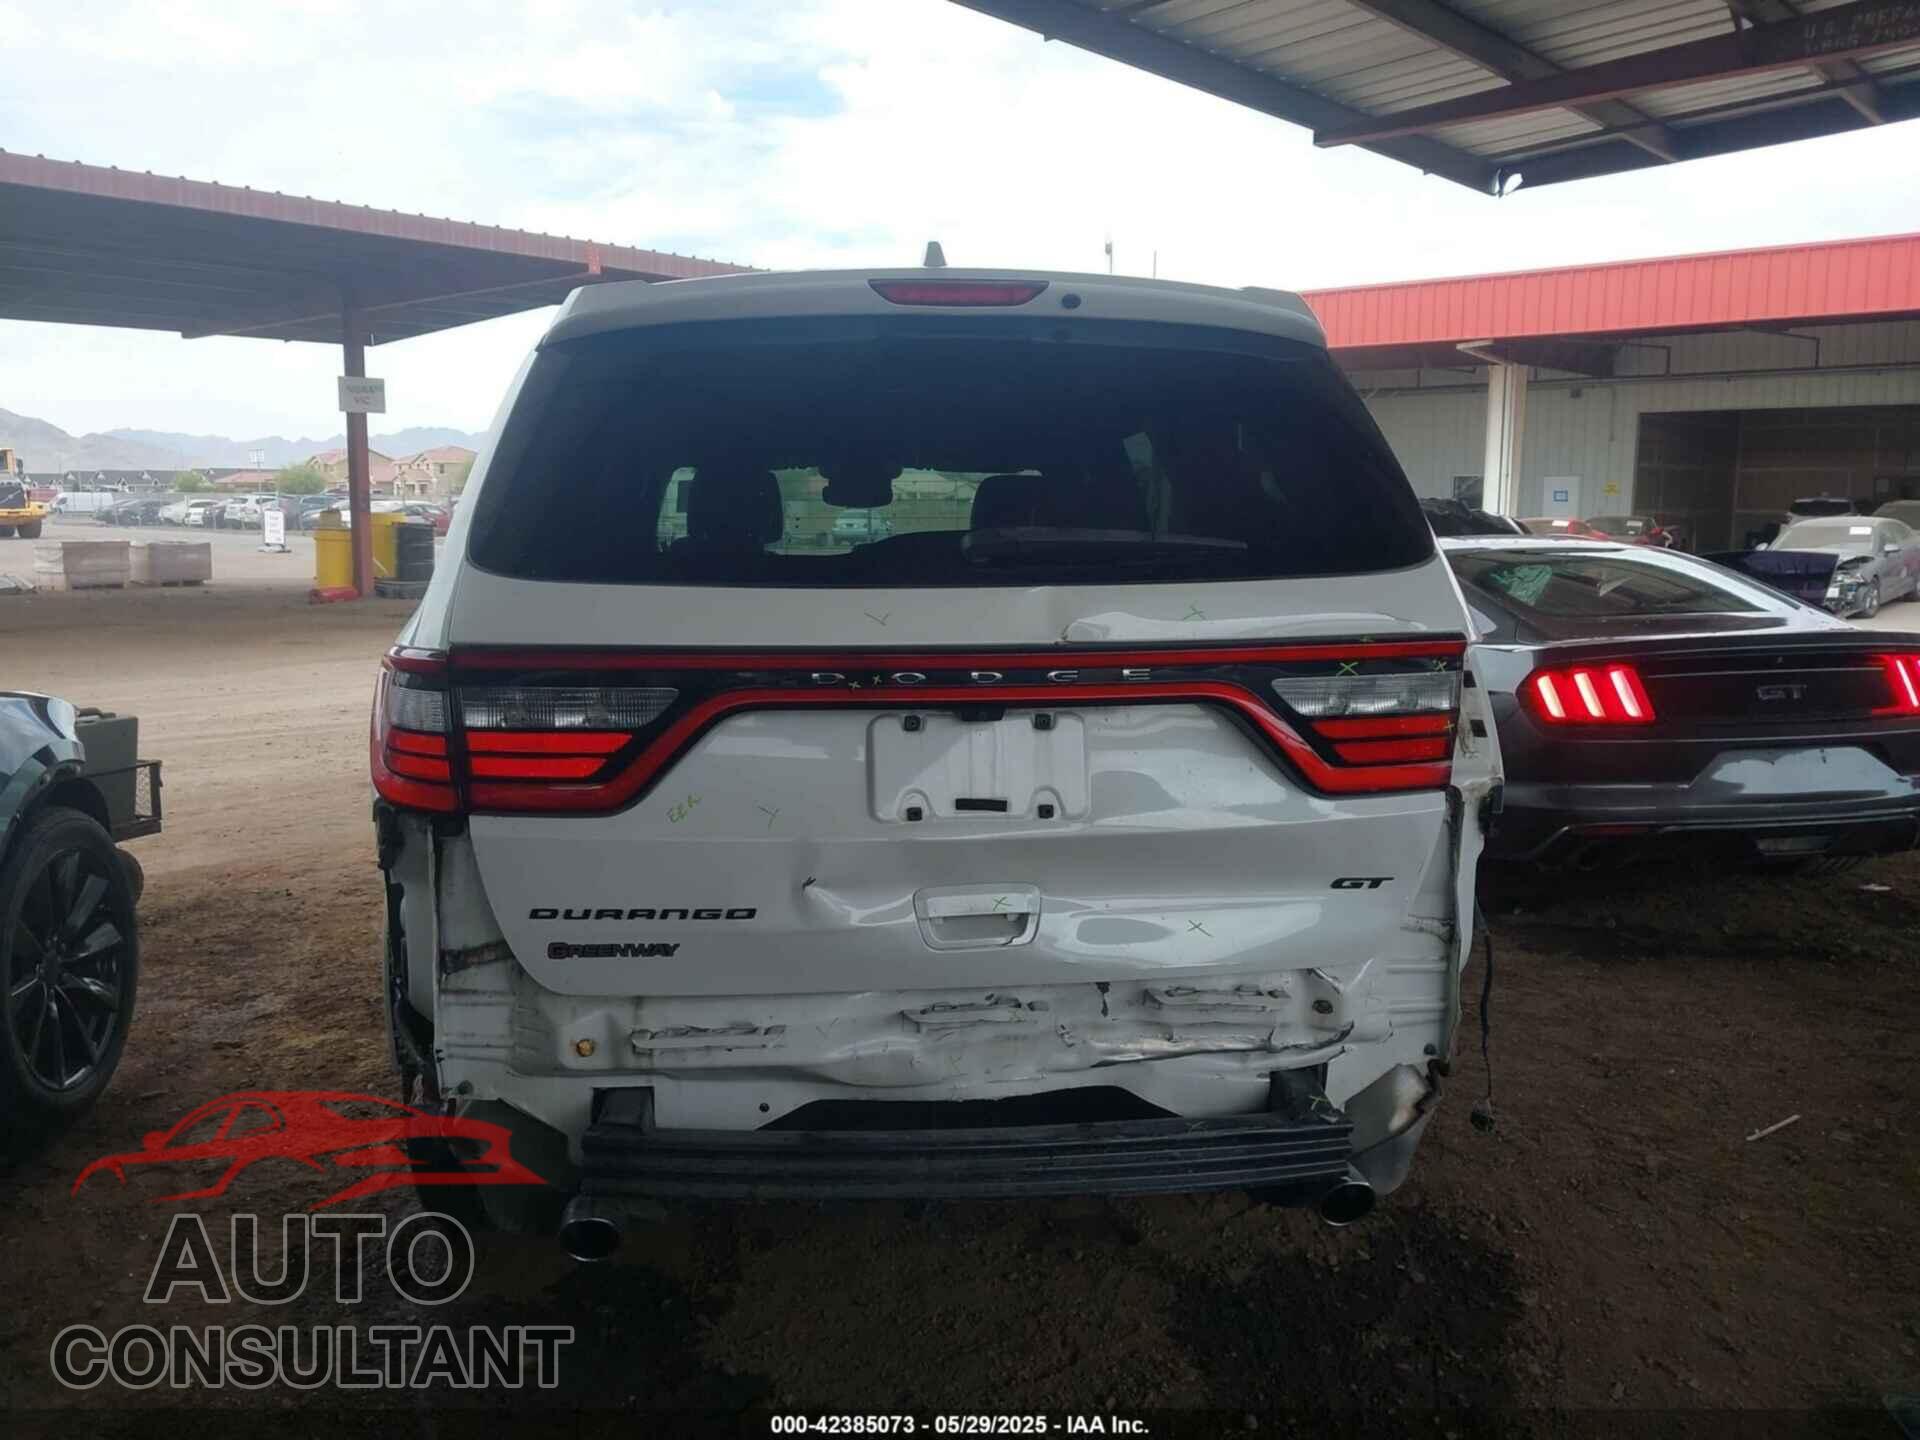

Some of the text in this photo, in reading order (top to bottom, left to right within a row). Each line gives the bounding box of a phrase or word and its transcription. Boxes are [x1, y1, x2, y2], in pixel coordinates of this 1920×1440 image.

[811, 668, 1151, 685] DODGE
[1756, 684, 1807, 701] GT
[1329, 876, 1395, 889] GT
[528, 907, 757, 921] DURANGO
[547, 942, 680, 960] GREENWAY
